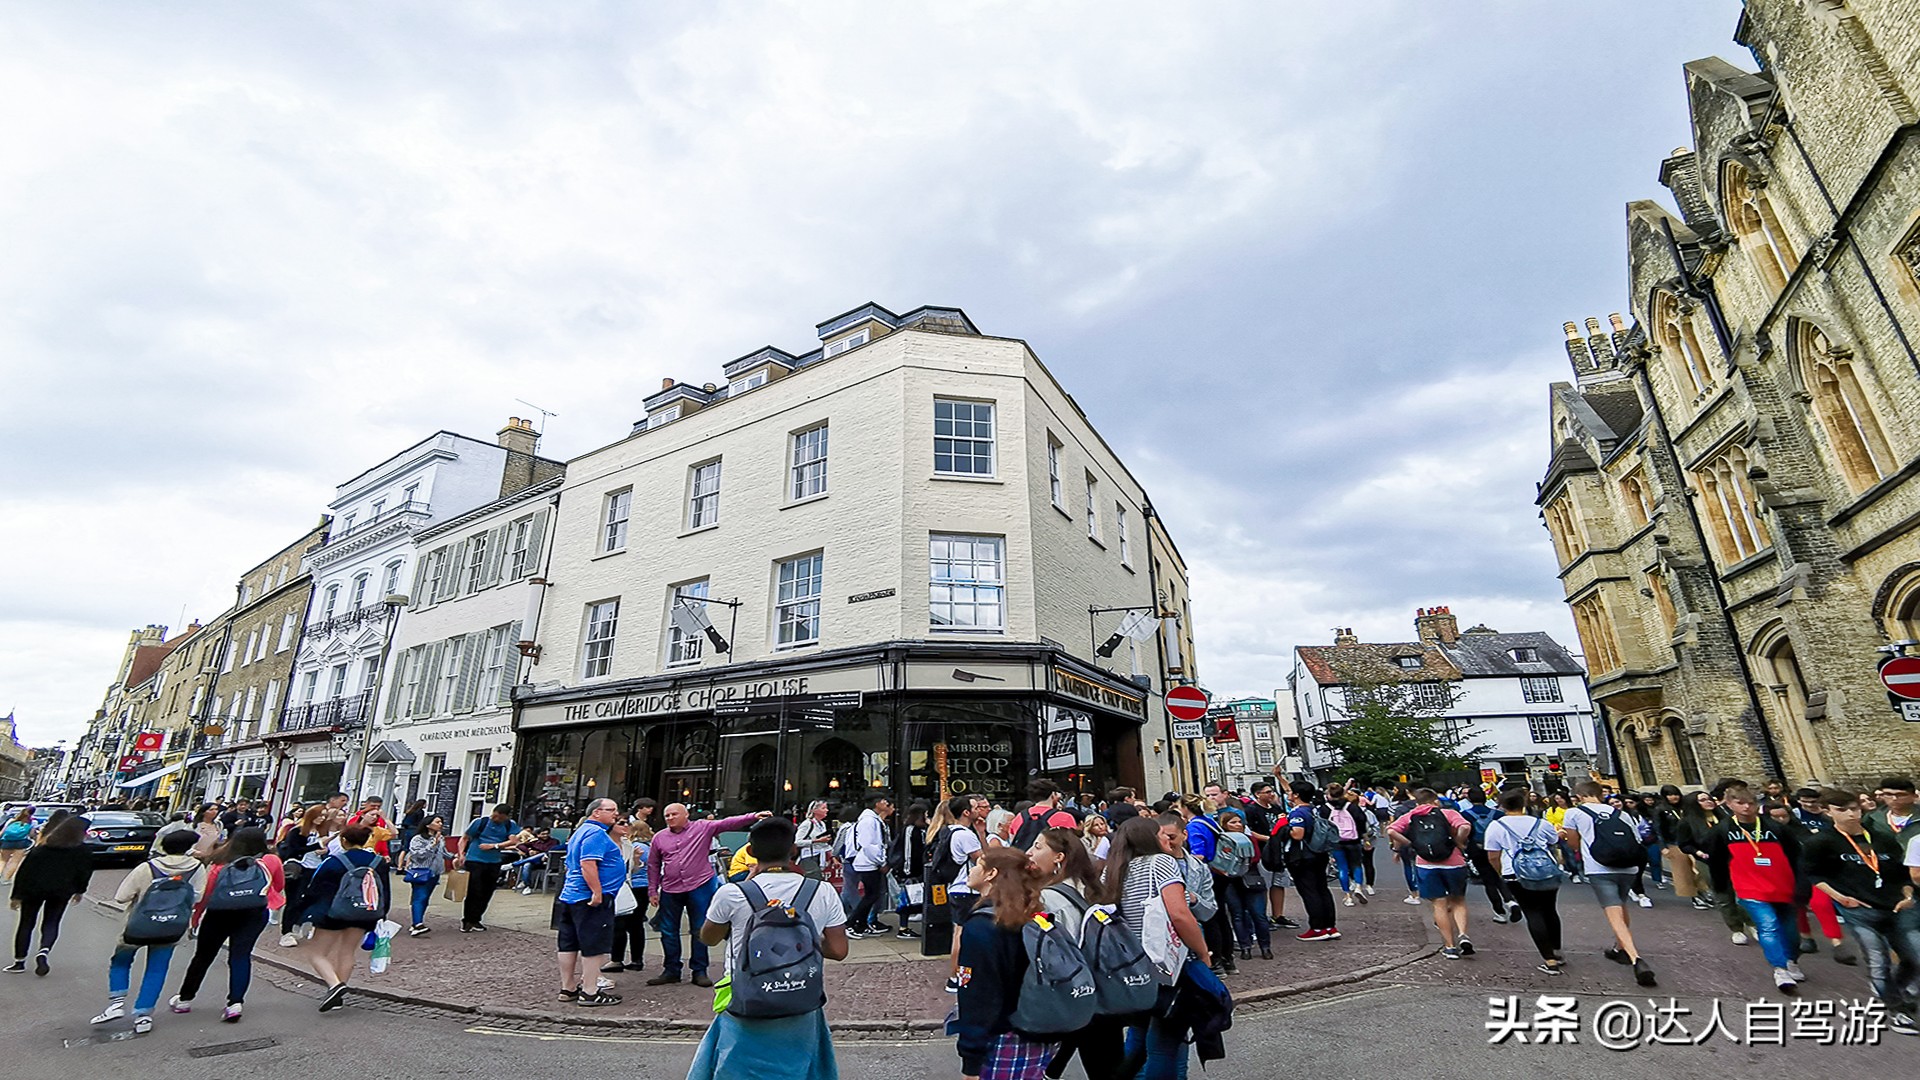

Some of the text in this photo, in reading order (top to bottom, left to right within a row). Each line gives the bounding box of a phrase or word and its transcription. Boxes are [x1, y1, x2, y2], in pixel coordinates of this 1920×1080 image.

[564, 677, 809, 721] THE CAMBRIDGE CHOP HOUSE
[420, 725, 510, 741] CAMBRIDGE WINE MERCHANTS
